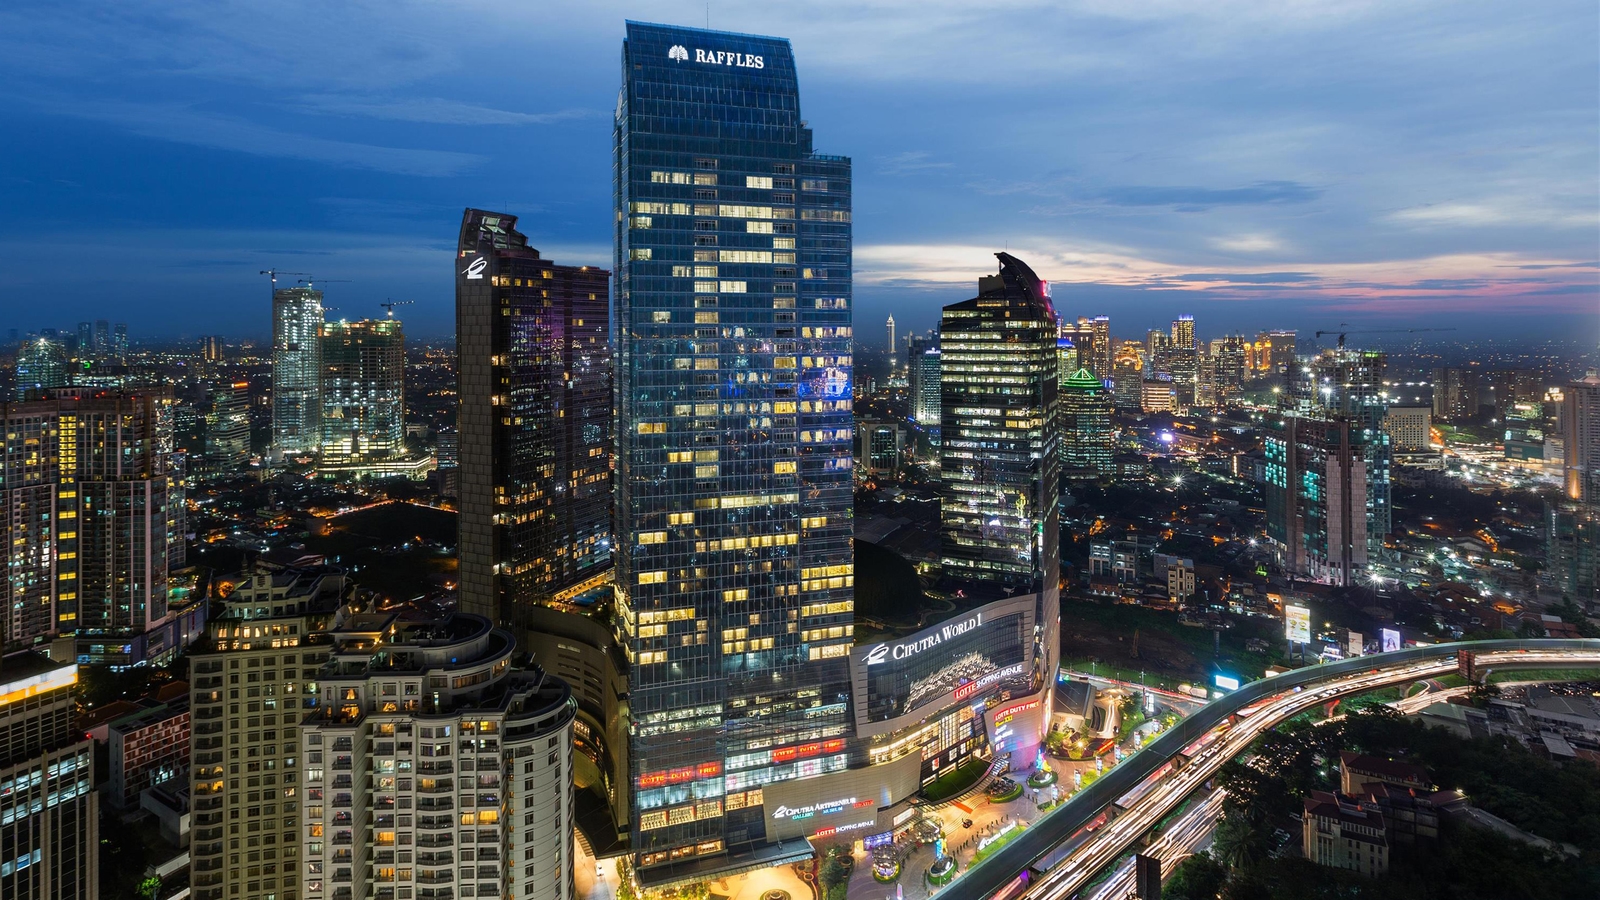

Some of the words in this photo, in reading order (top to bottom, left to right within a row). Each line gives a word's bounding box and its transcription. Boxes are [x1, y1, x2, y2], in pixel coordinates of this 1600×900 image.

[695, 48, 765, 69] RAFFLES
[892, 633, 941, 660] CIPUTRA
[942, 618, 976, 641] WORLD
[976, 612, 982, 627] 1
[955, 682, 977, 699] LOTTE
[976, 671, 1000, 689] SHOPPING
[1000, 664, 1022, 678] AVENUE
[1009, 704, 1026, 714] DUTY
[642, 775, 665, 784] LOTTE
[671, 770, 691, 779] DUTY
[699, 766, 718, 774] FREE
[785, 805, 815, 816] CIPUTRA
[814, 797, 856, 811] ARTPRENEUR
[817, 828, 836, 837] LOTTE
[836, 823, 857, 833] SHOPPING
[857, 820, 874, 828] AVENUE
